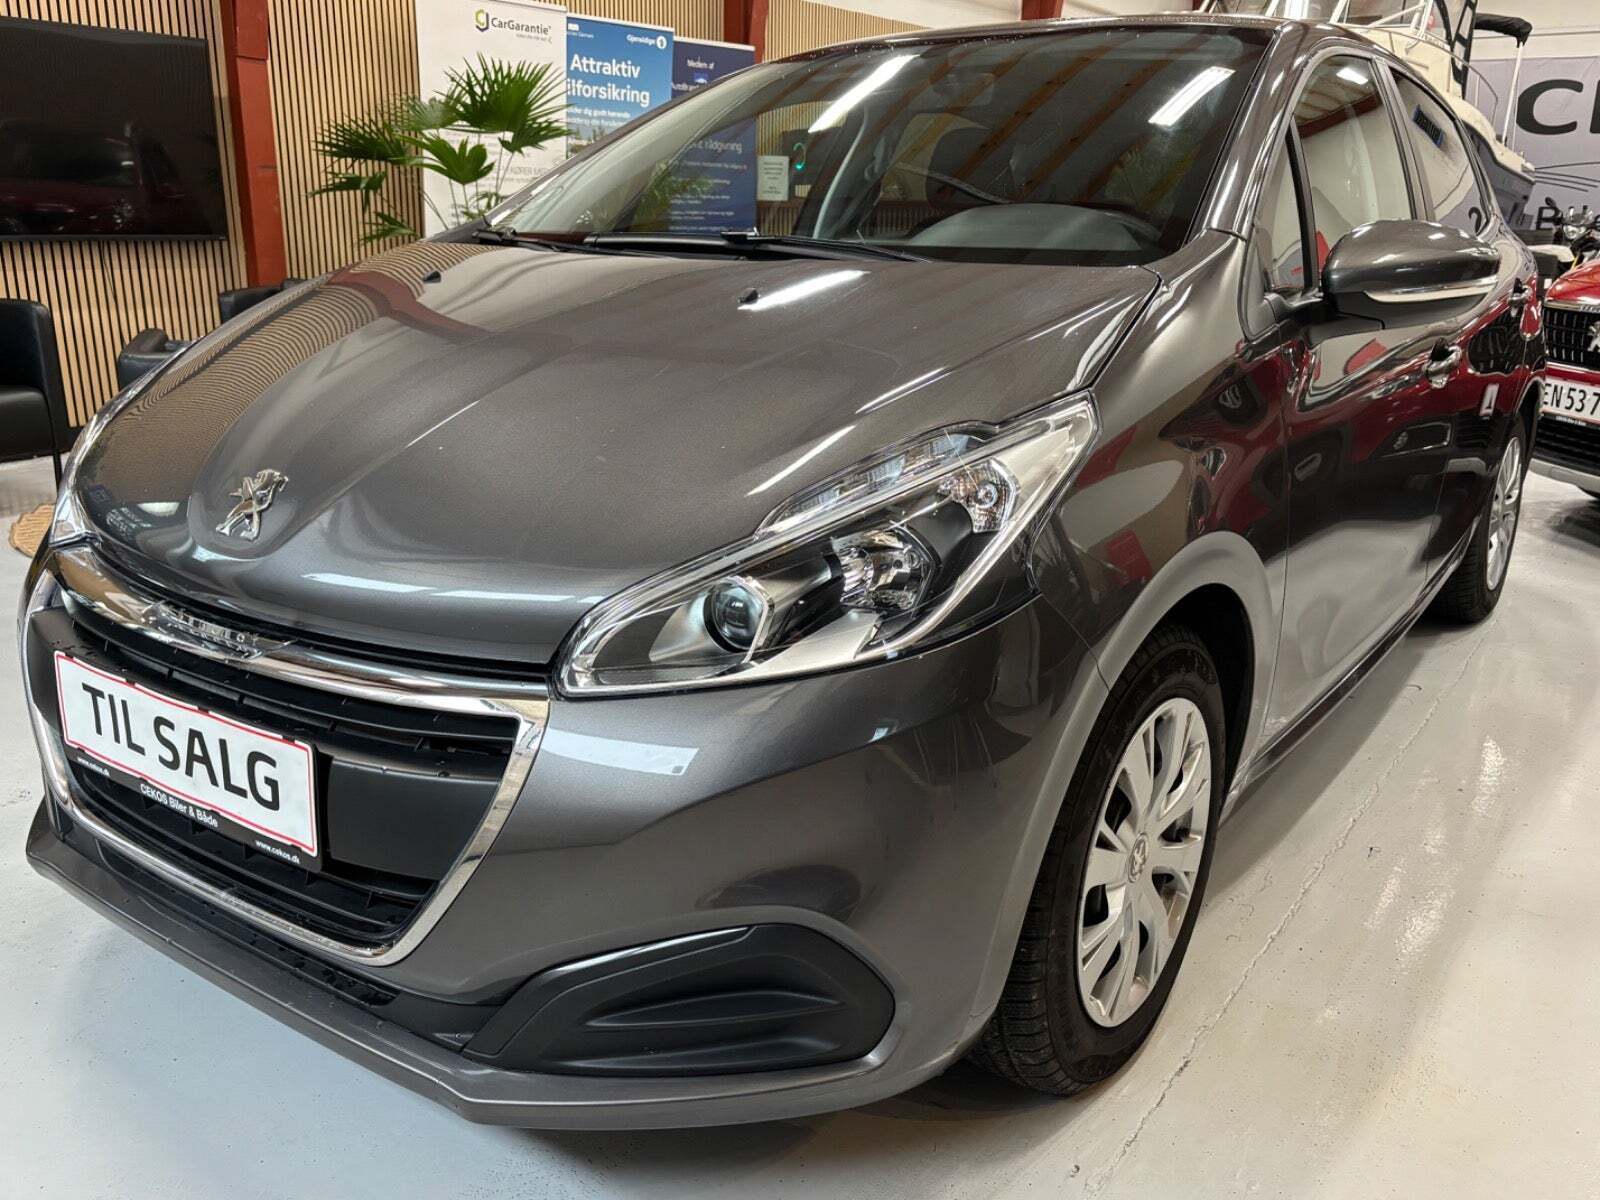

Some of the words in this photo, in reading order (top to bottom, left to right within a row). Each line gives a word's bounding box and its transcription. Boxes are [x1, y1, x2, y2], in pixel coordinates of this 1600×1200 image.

[491, 17, 549, 35] CarGarantie
[570, 53, 641, 78] Attraktiv
[567, 78, 650, 108] ilforsikring
[1516, 79, 1600, 136] C
[1565, 387, 1587, 412] 53
[81, 682, 146, 756] TIL
[153, 715, 280, 811] SALG
[140, 783, 168, 804] CEKOS
[169, 796, 188, 815] Biler
